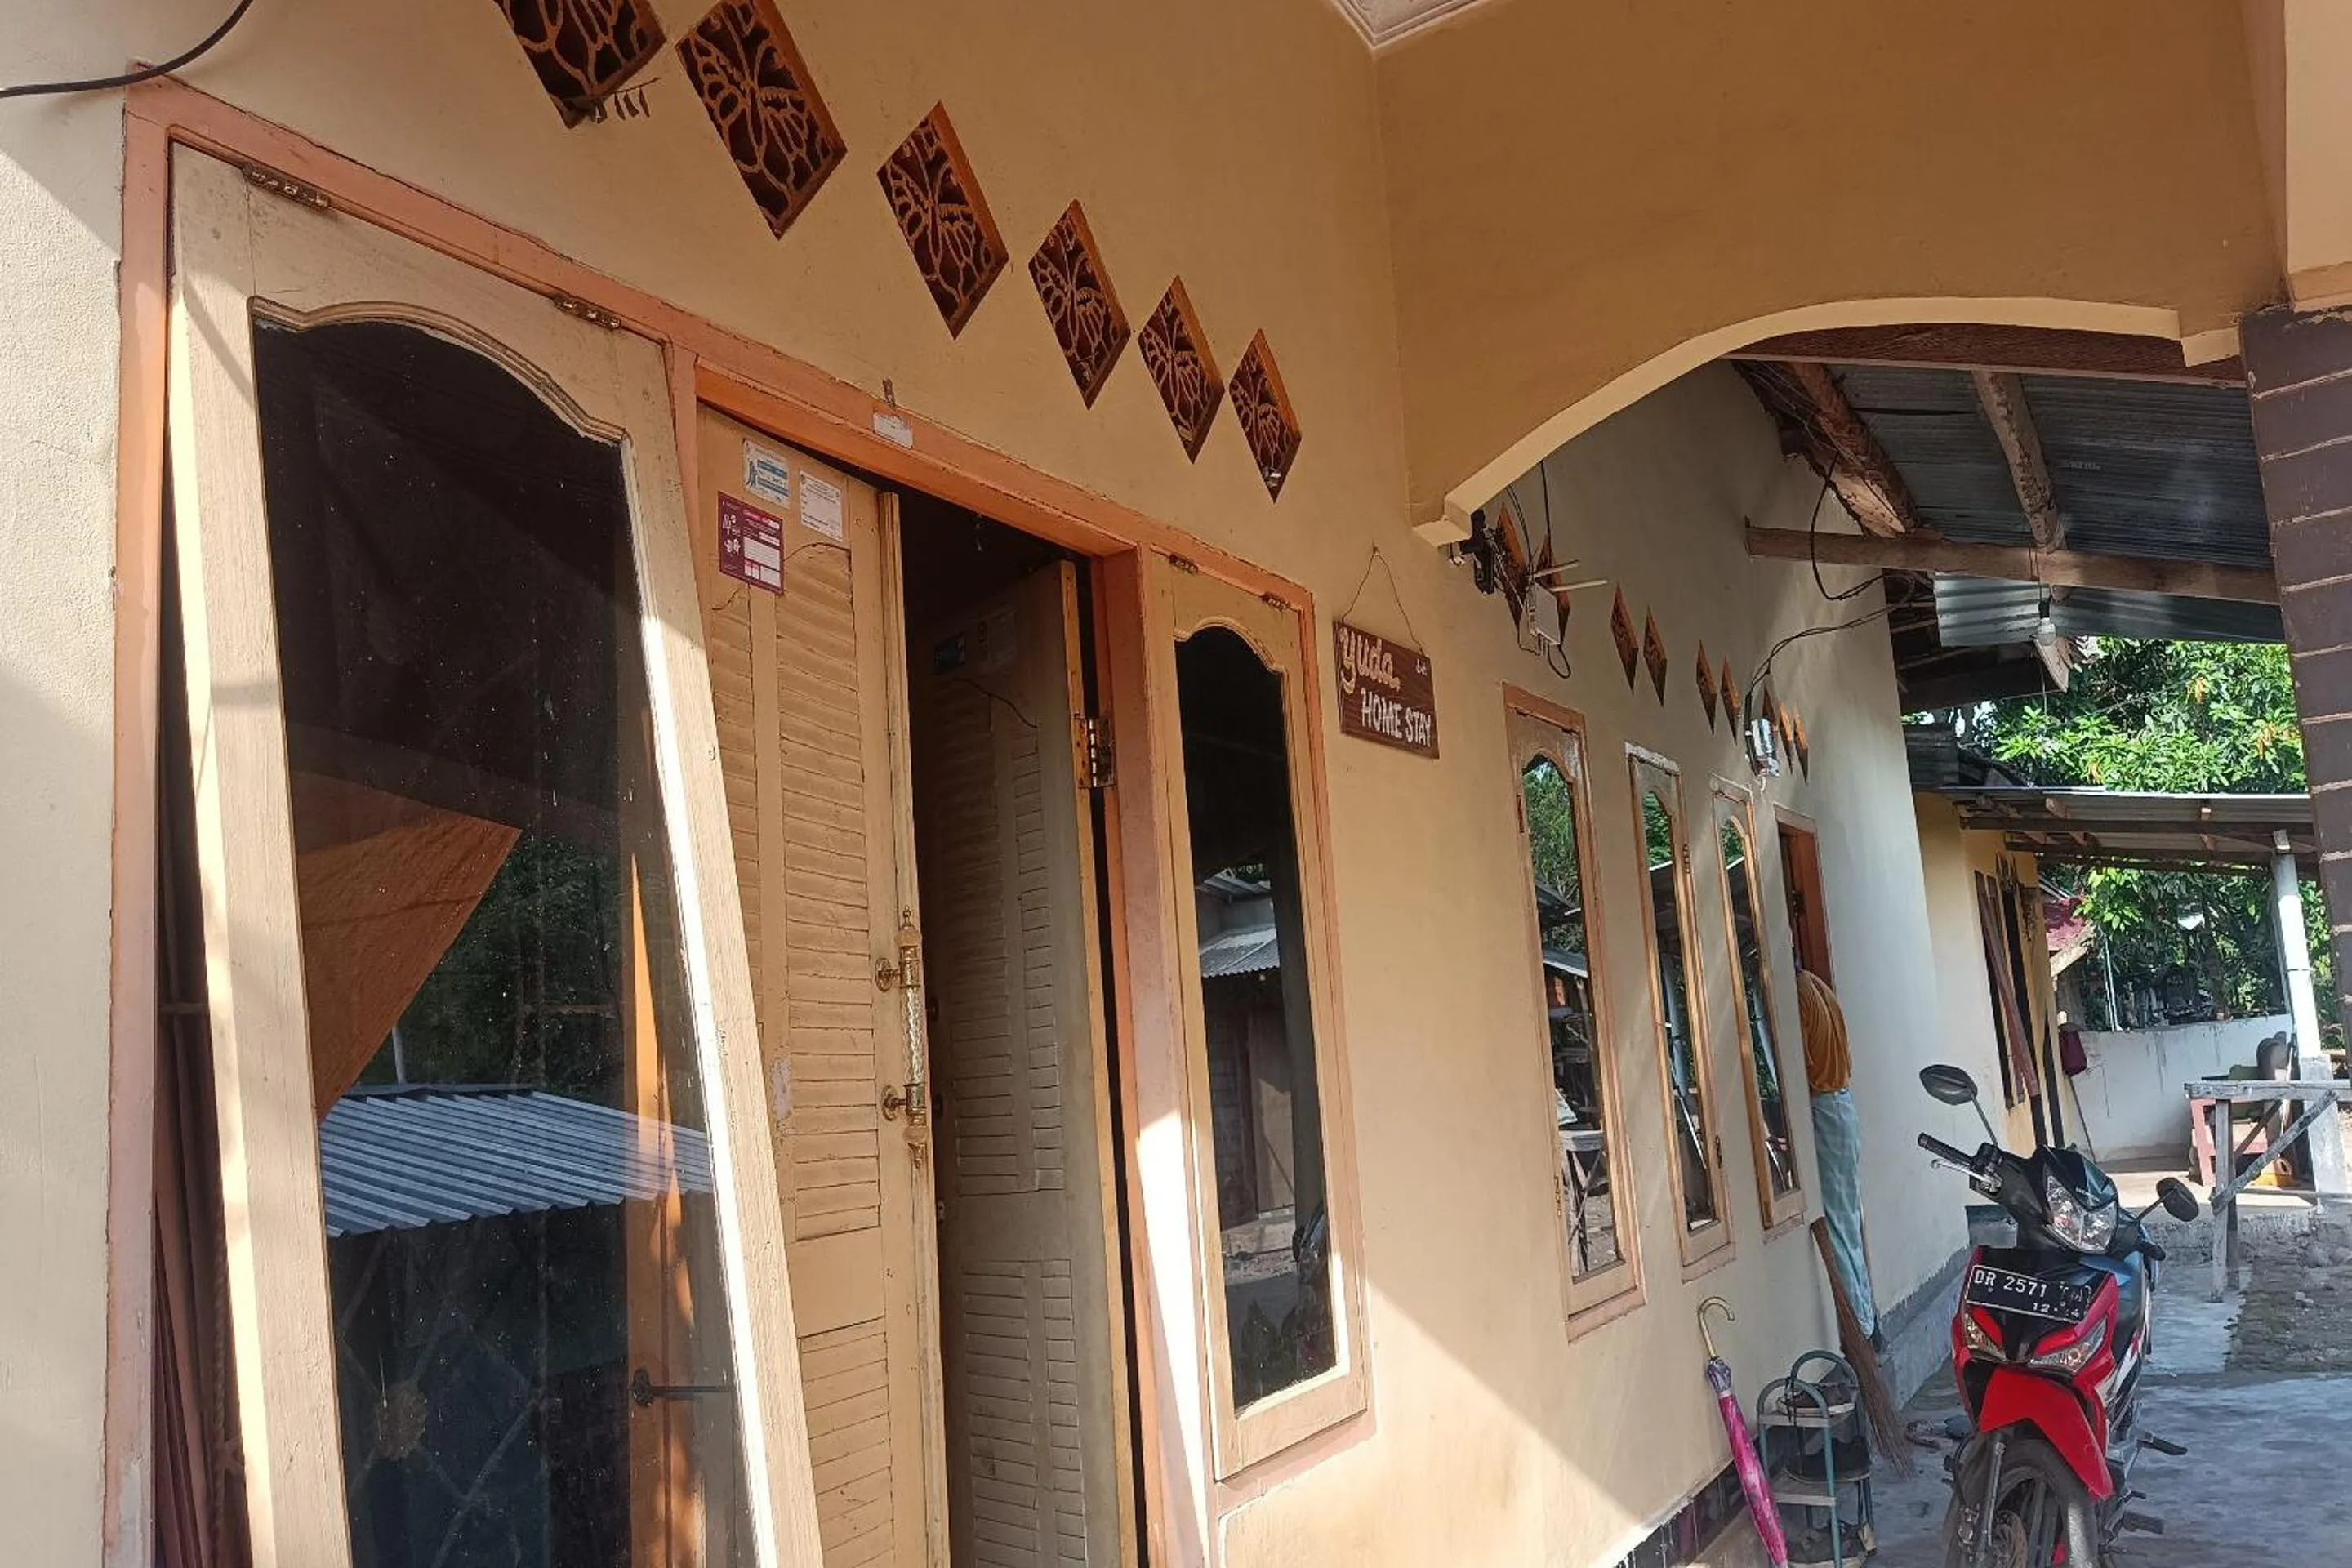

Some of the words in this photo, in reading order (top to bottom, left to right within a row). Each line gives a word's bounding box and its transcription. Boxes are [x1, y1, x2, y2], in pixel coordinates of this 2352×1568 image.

[1361, 688, 1402, 738] HOME
[1405, 707, 1431, 746] STAY
[1975, 1269, 1997, 1287] DR
[2003, 1277, 2047, 1298] 2571
